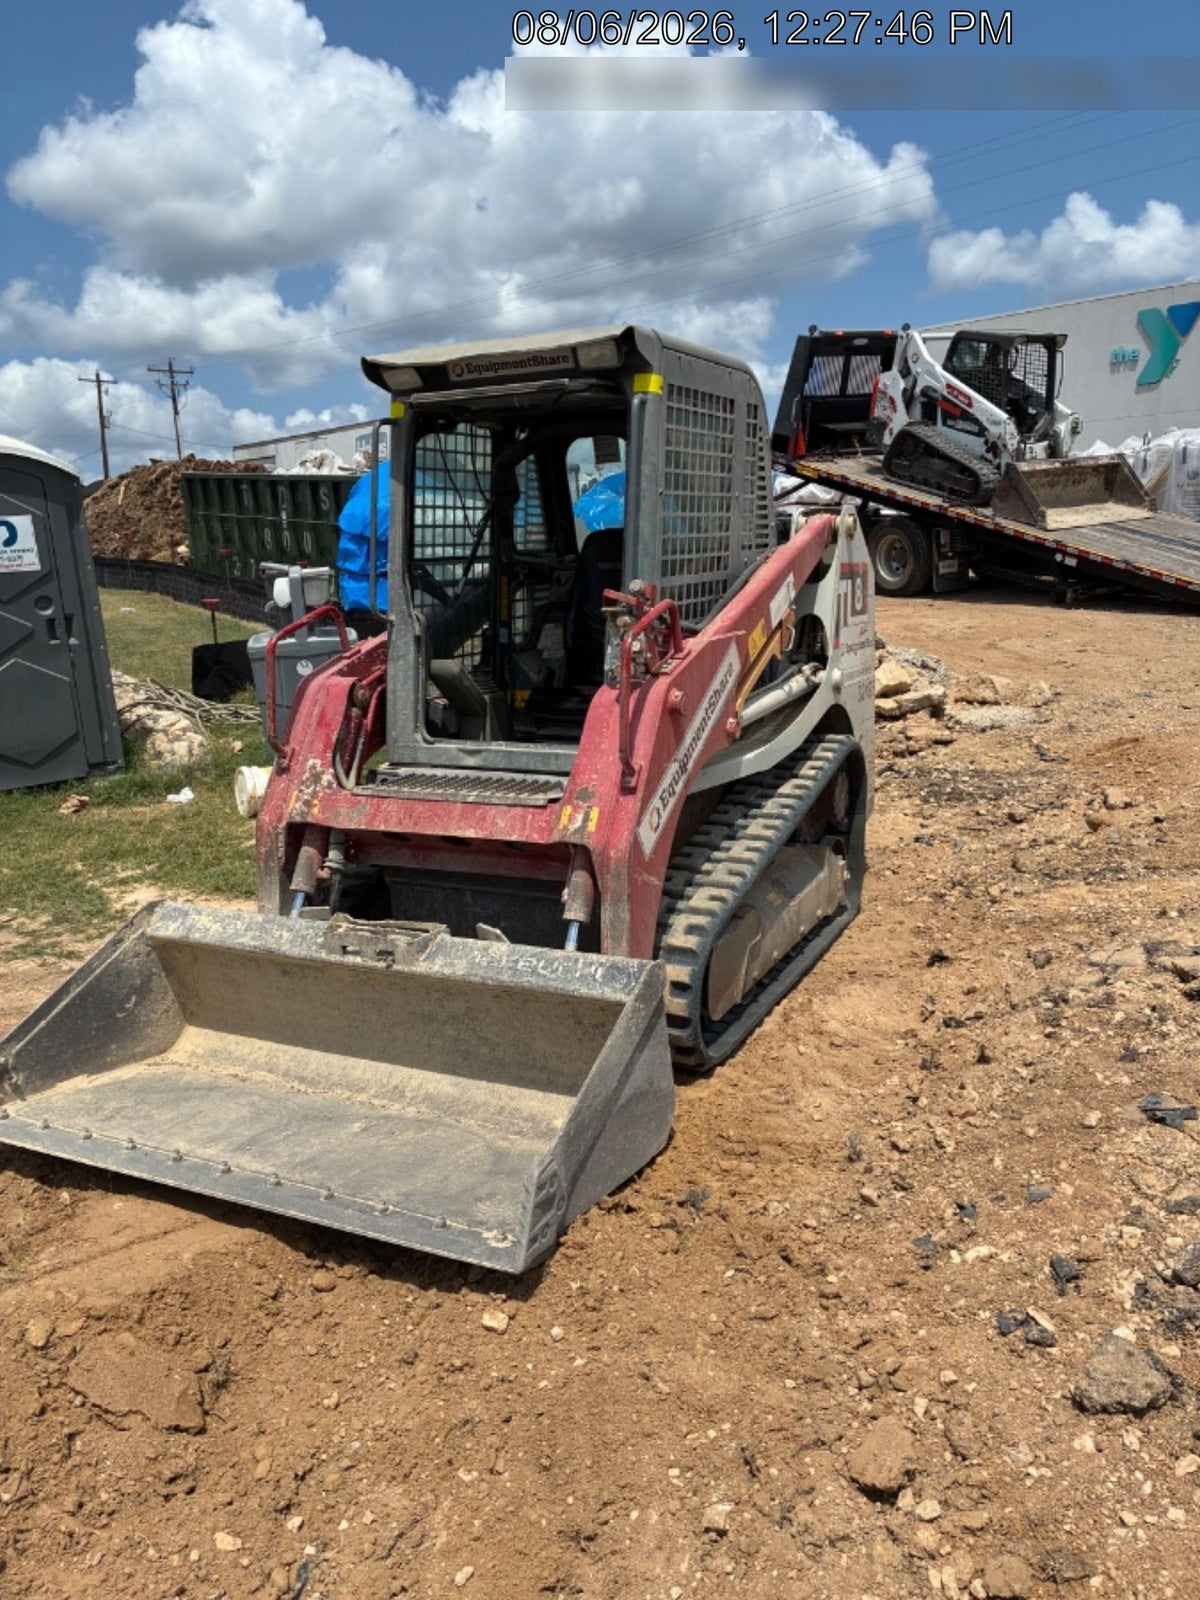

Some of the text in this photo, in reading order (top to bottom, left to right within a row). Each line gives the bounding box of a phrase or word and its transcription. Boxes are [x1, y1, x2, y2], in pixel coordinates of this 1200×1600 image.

[465, 354, 570, 376] EquipmentShare
[1110, 346, 1139, 364] the
[658, 661, 735, 808] EquipmentShare
